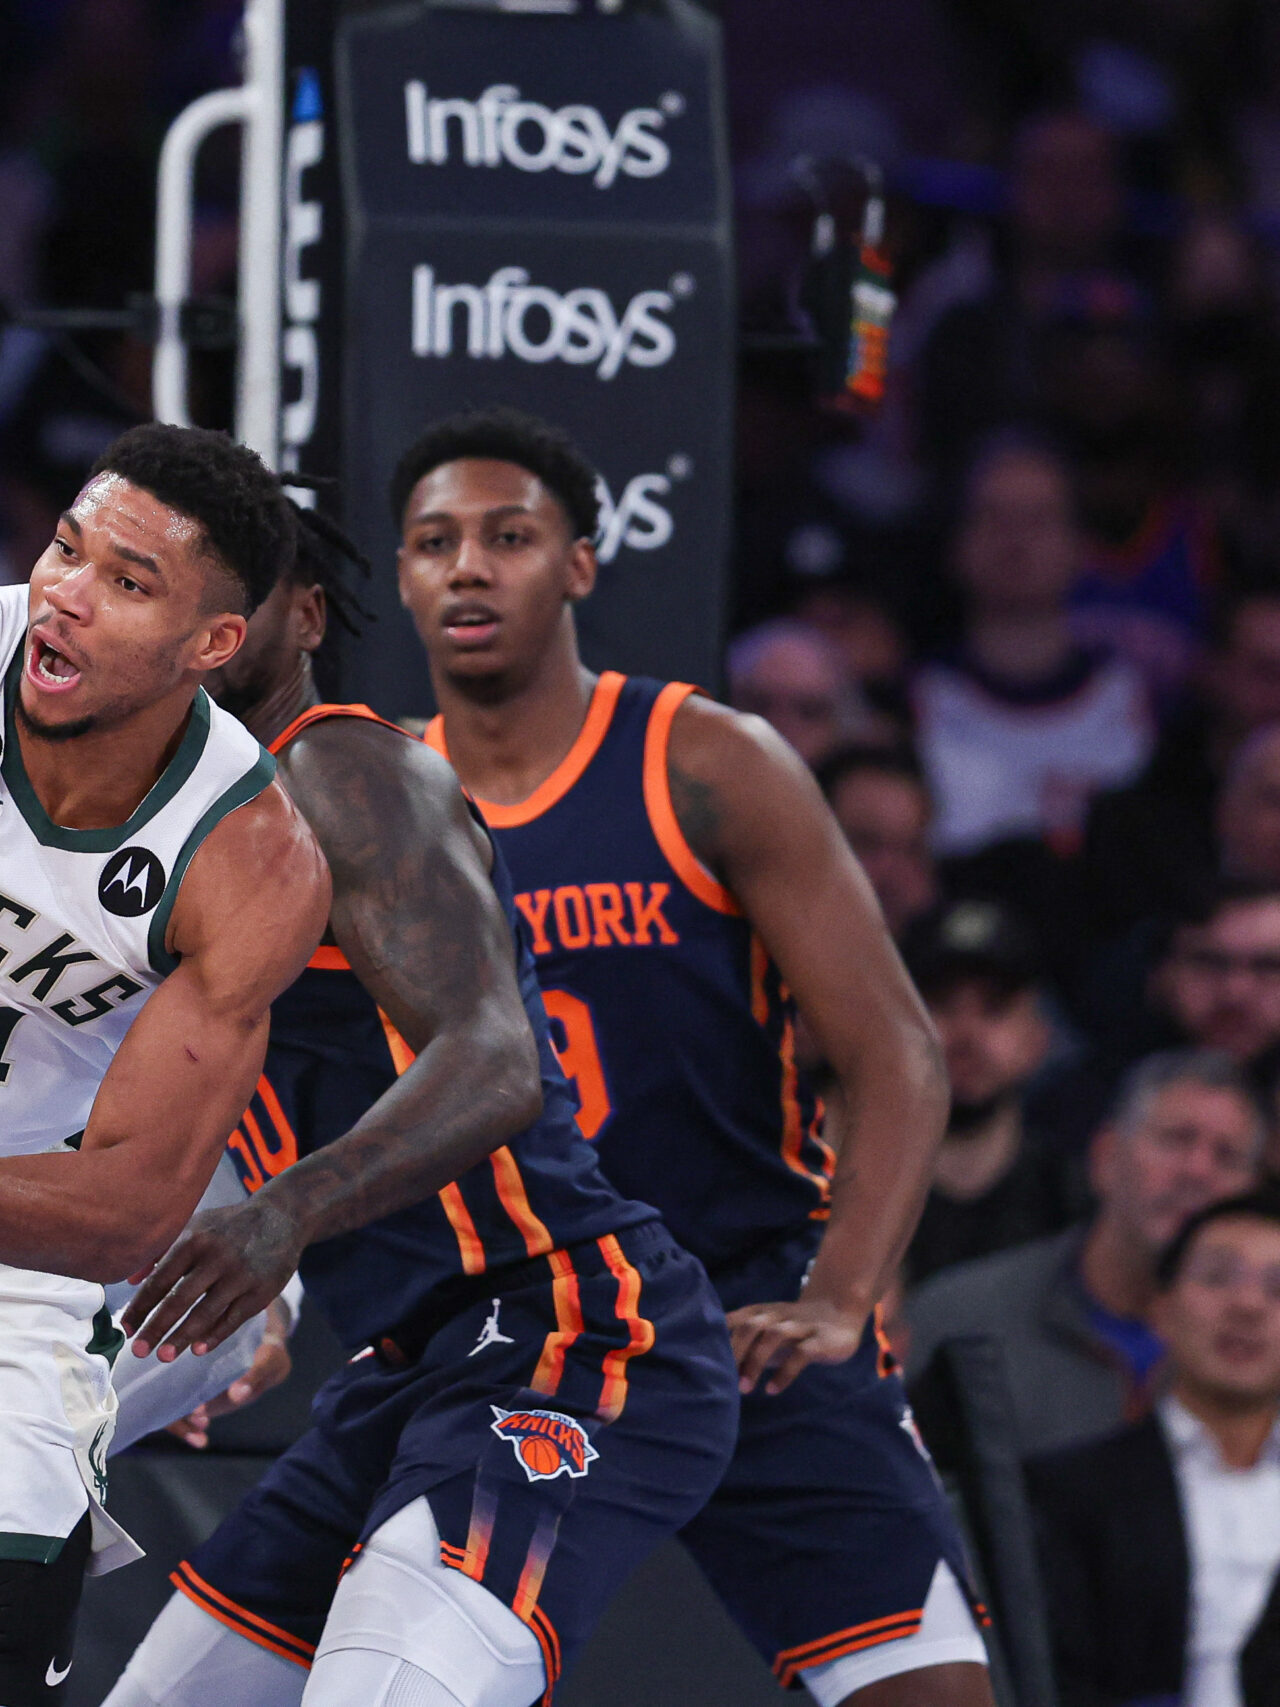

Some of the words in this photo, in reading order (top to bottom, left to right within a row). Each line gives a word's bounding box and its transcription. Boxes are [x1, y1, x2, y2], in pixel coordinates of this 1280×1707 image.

[404, 79, 672, 189] Infosys
[412, 263, 677, 381] Infosys
[513, 882, 680, 954] YORK
[497, 1412, 585, 1471] KNICKS
